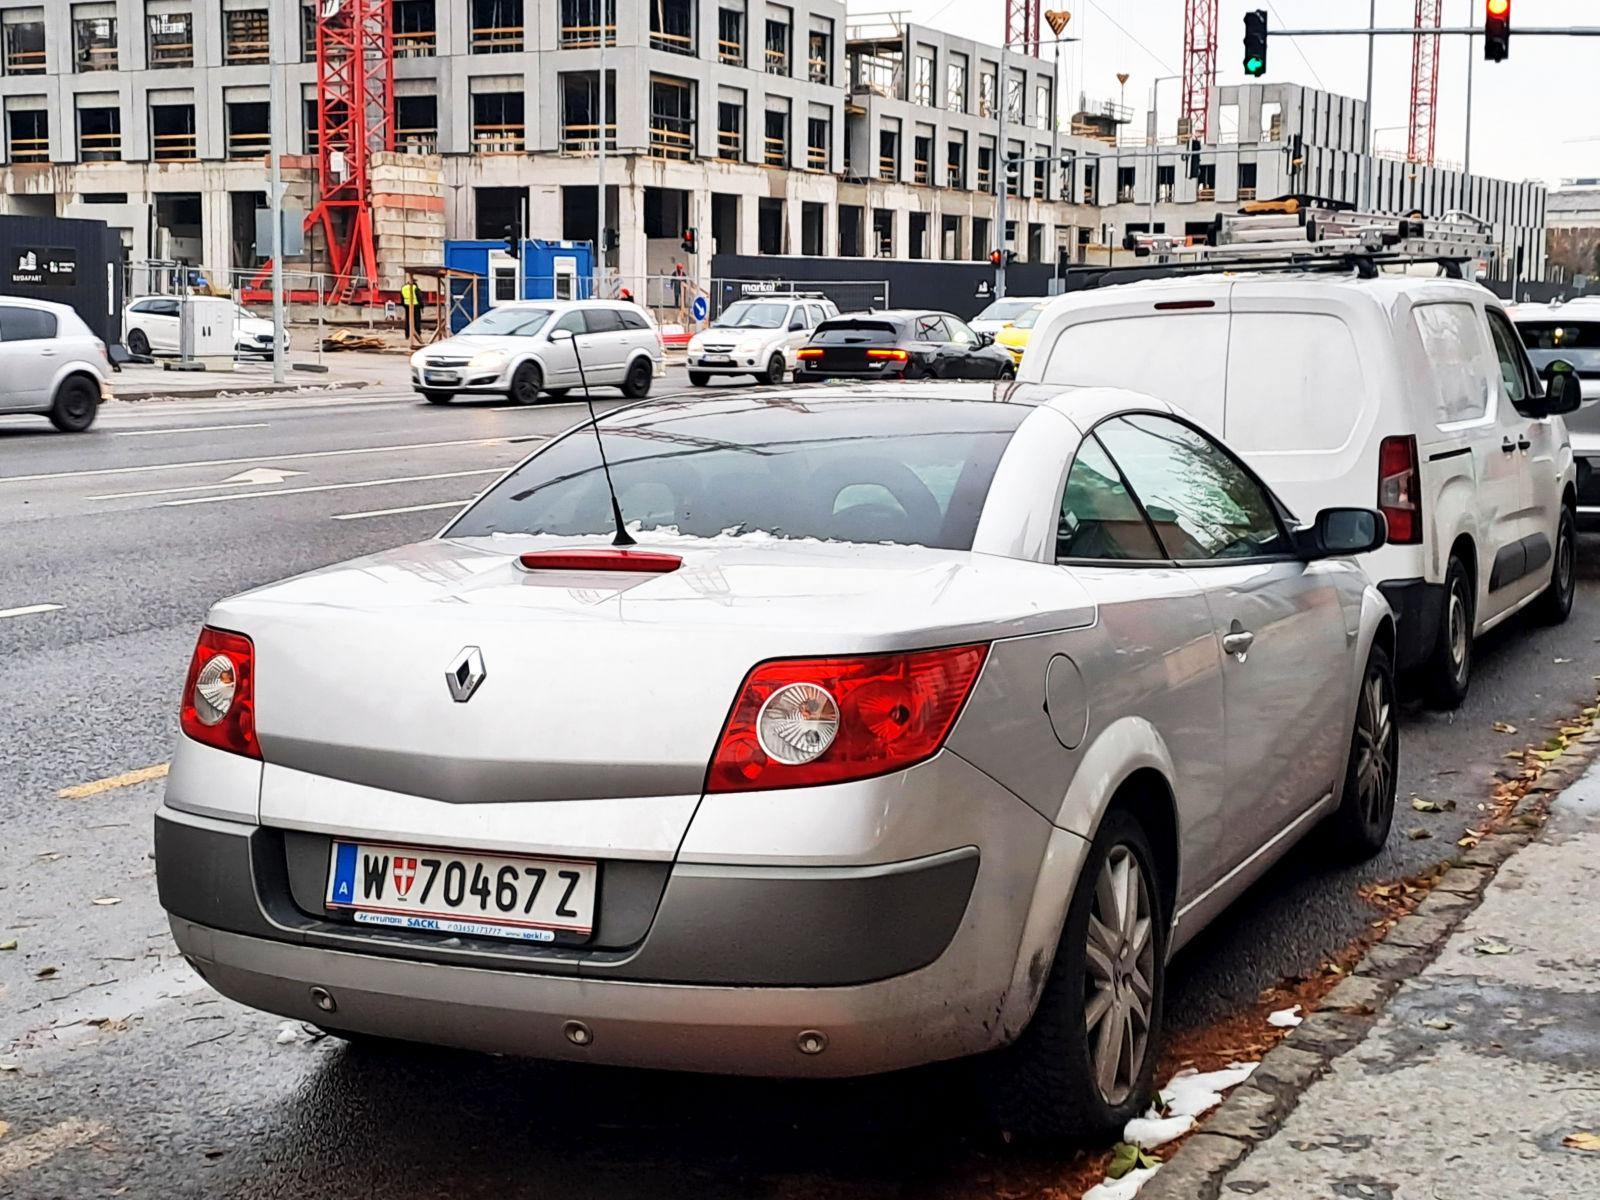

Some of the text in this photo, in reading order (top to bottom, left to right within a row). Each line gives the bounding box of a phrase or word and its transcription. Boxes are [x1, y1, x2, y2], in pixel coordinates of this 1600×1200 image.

[363, 854, 389, 900] W
[337, 881, 348, 896] A
[407, 917, 440, 930] SACKL
